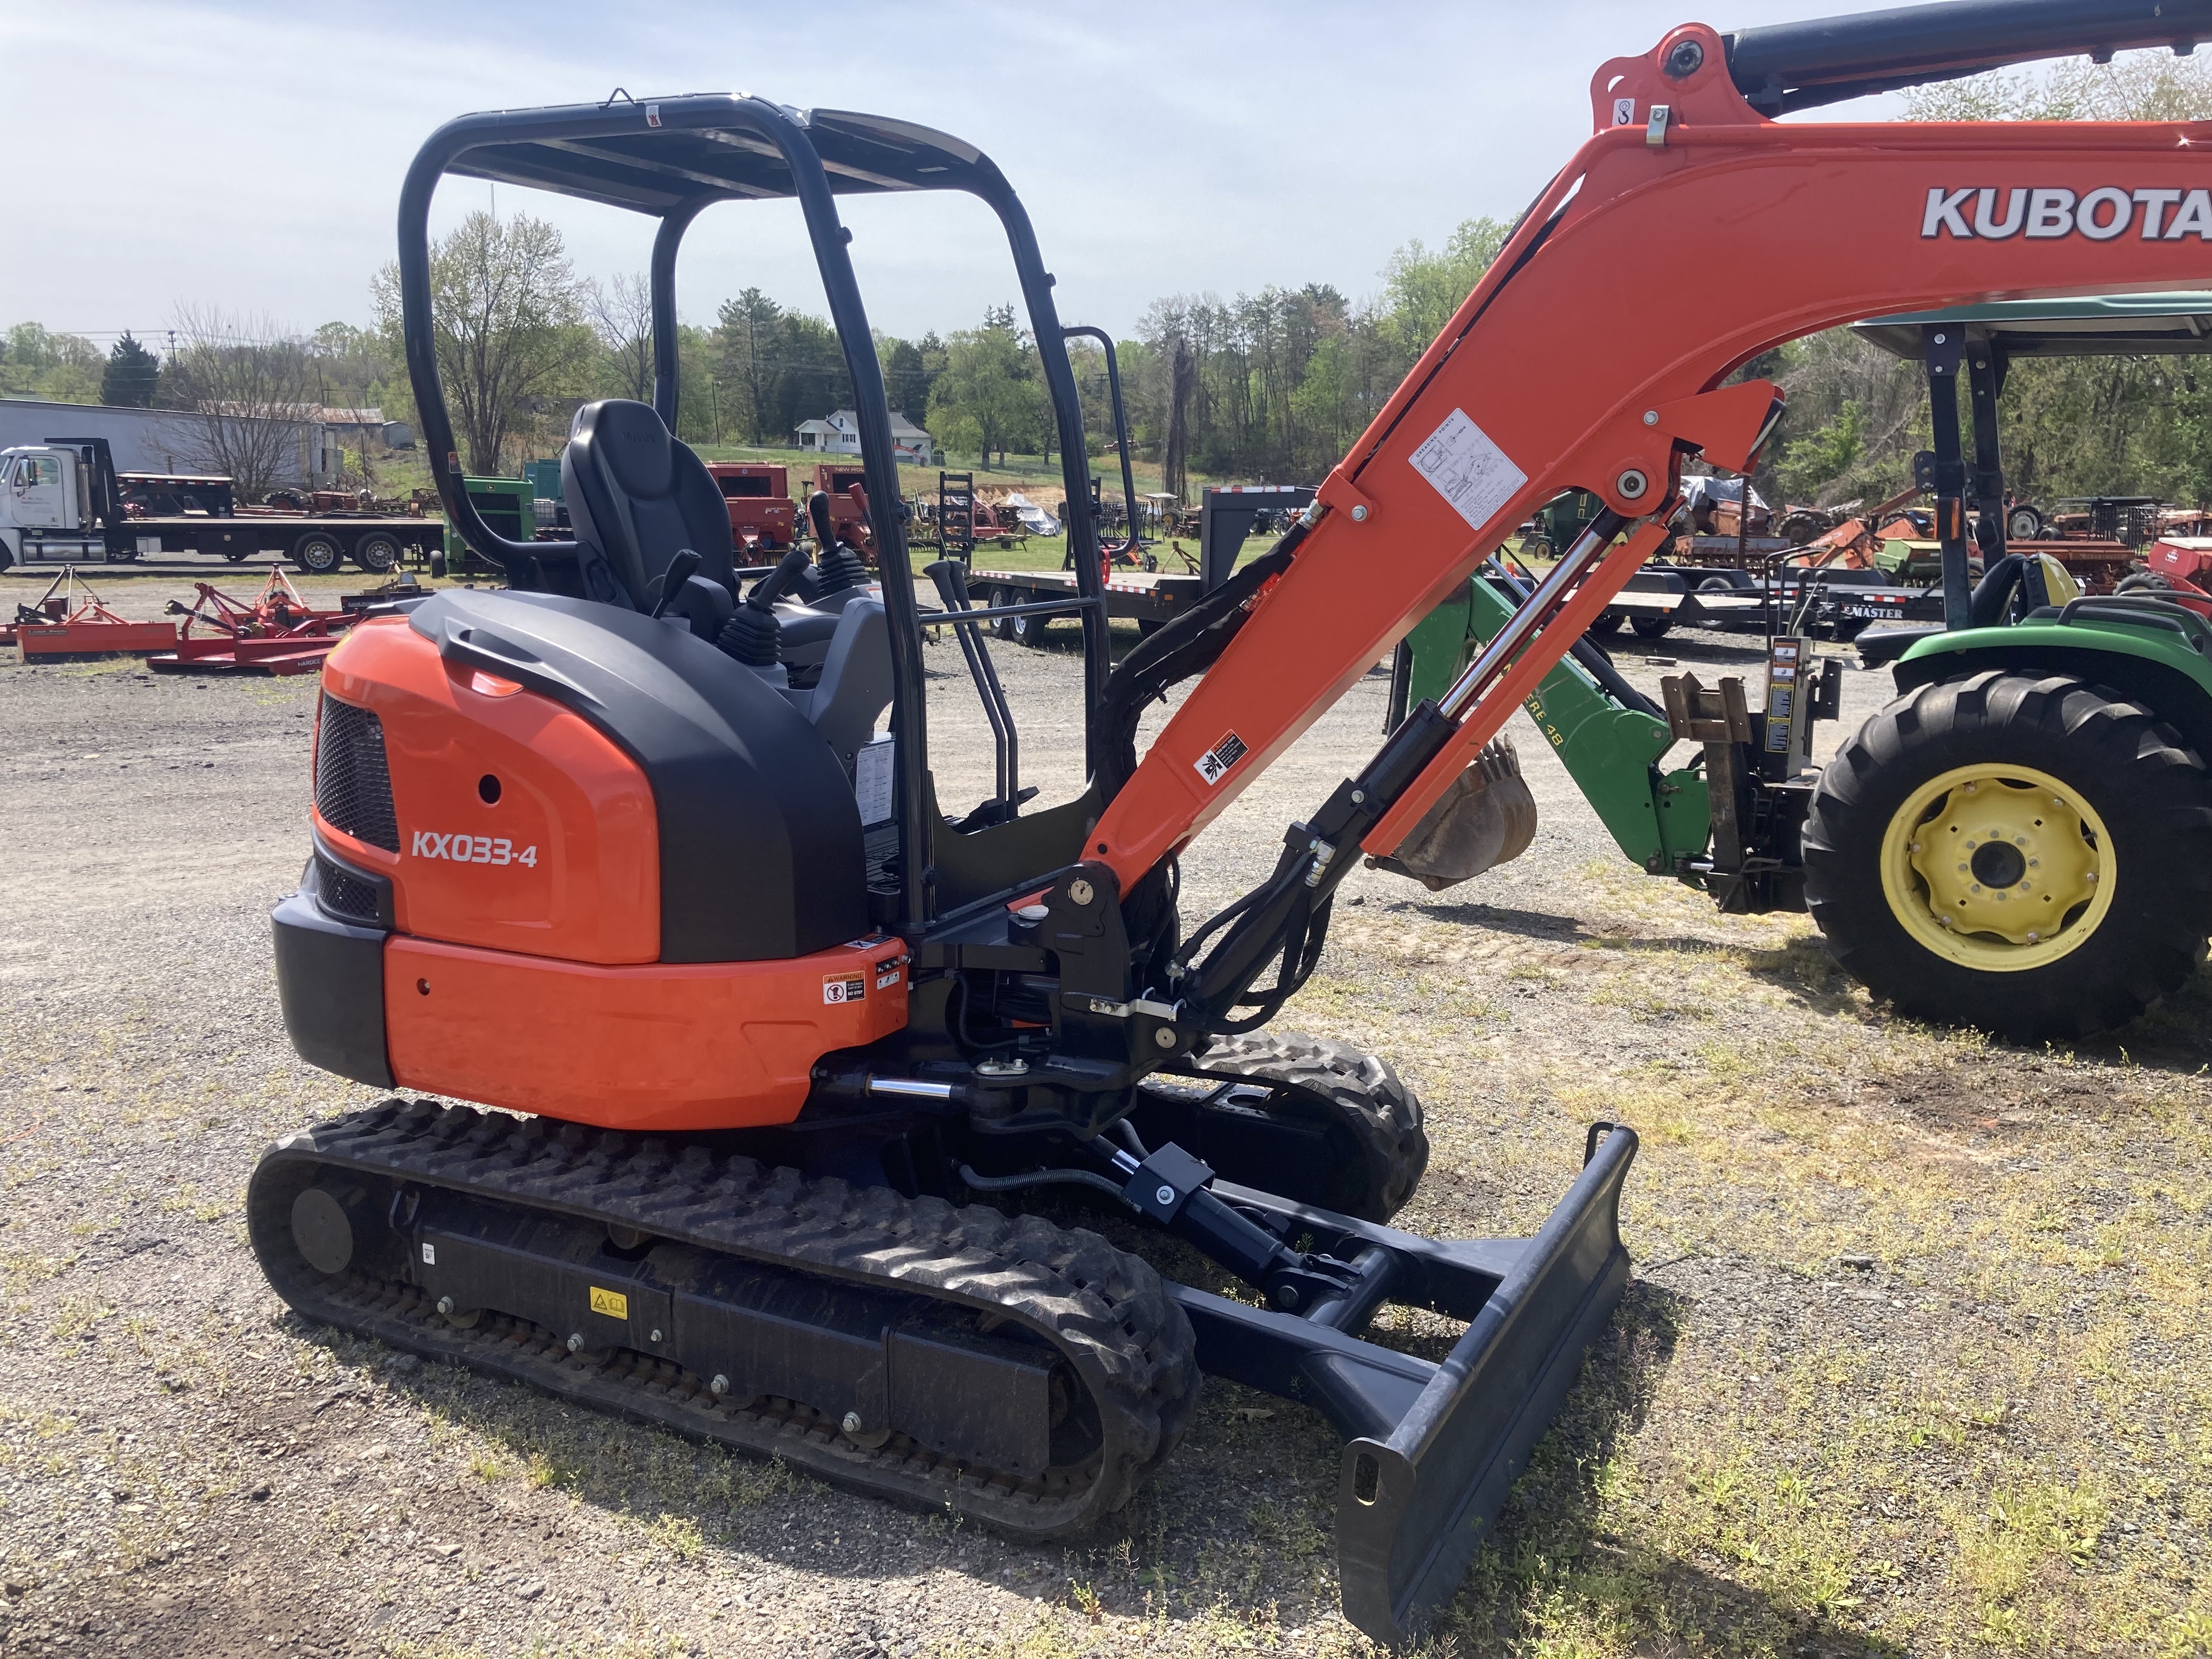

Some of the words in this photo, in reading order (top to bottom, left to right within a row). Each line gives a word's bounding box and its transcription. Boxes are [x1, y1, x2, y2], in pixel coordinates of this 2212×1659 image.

[1921, 187, 2211, 240] KUBOTA
[1416, 436, 1437, 458] GREASING
[1438, 417, 1454, 434] POINTS
[1852, 607, 1903, 619] MASTER
[298, 658, 321, 667] HARDEE
[1547, 724, 1564, 747] 48
[412, 831, 537, 868] KX033-4
[833, 973, 862, 981] WARNING
